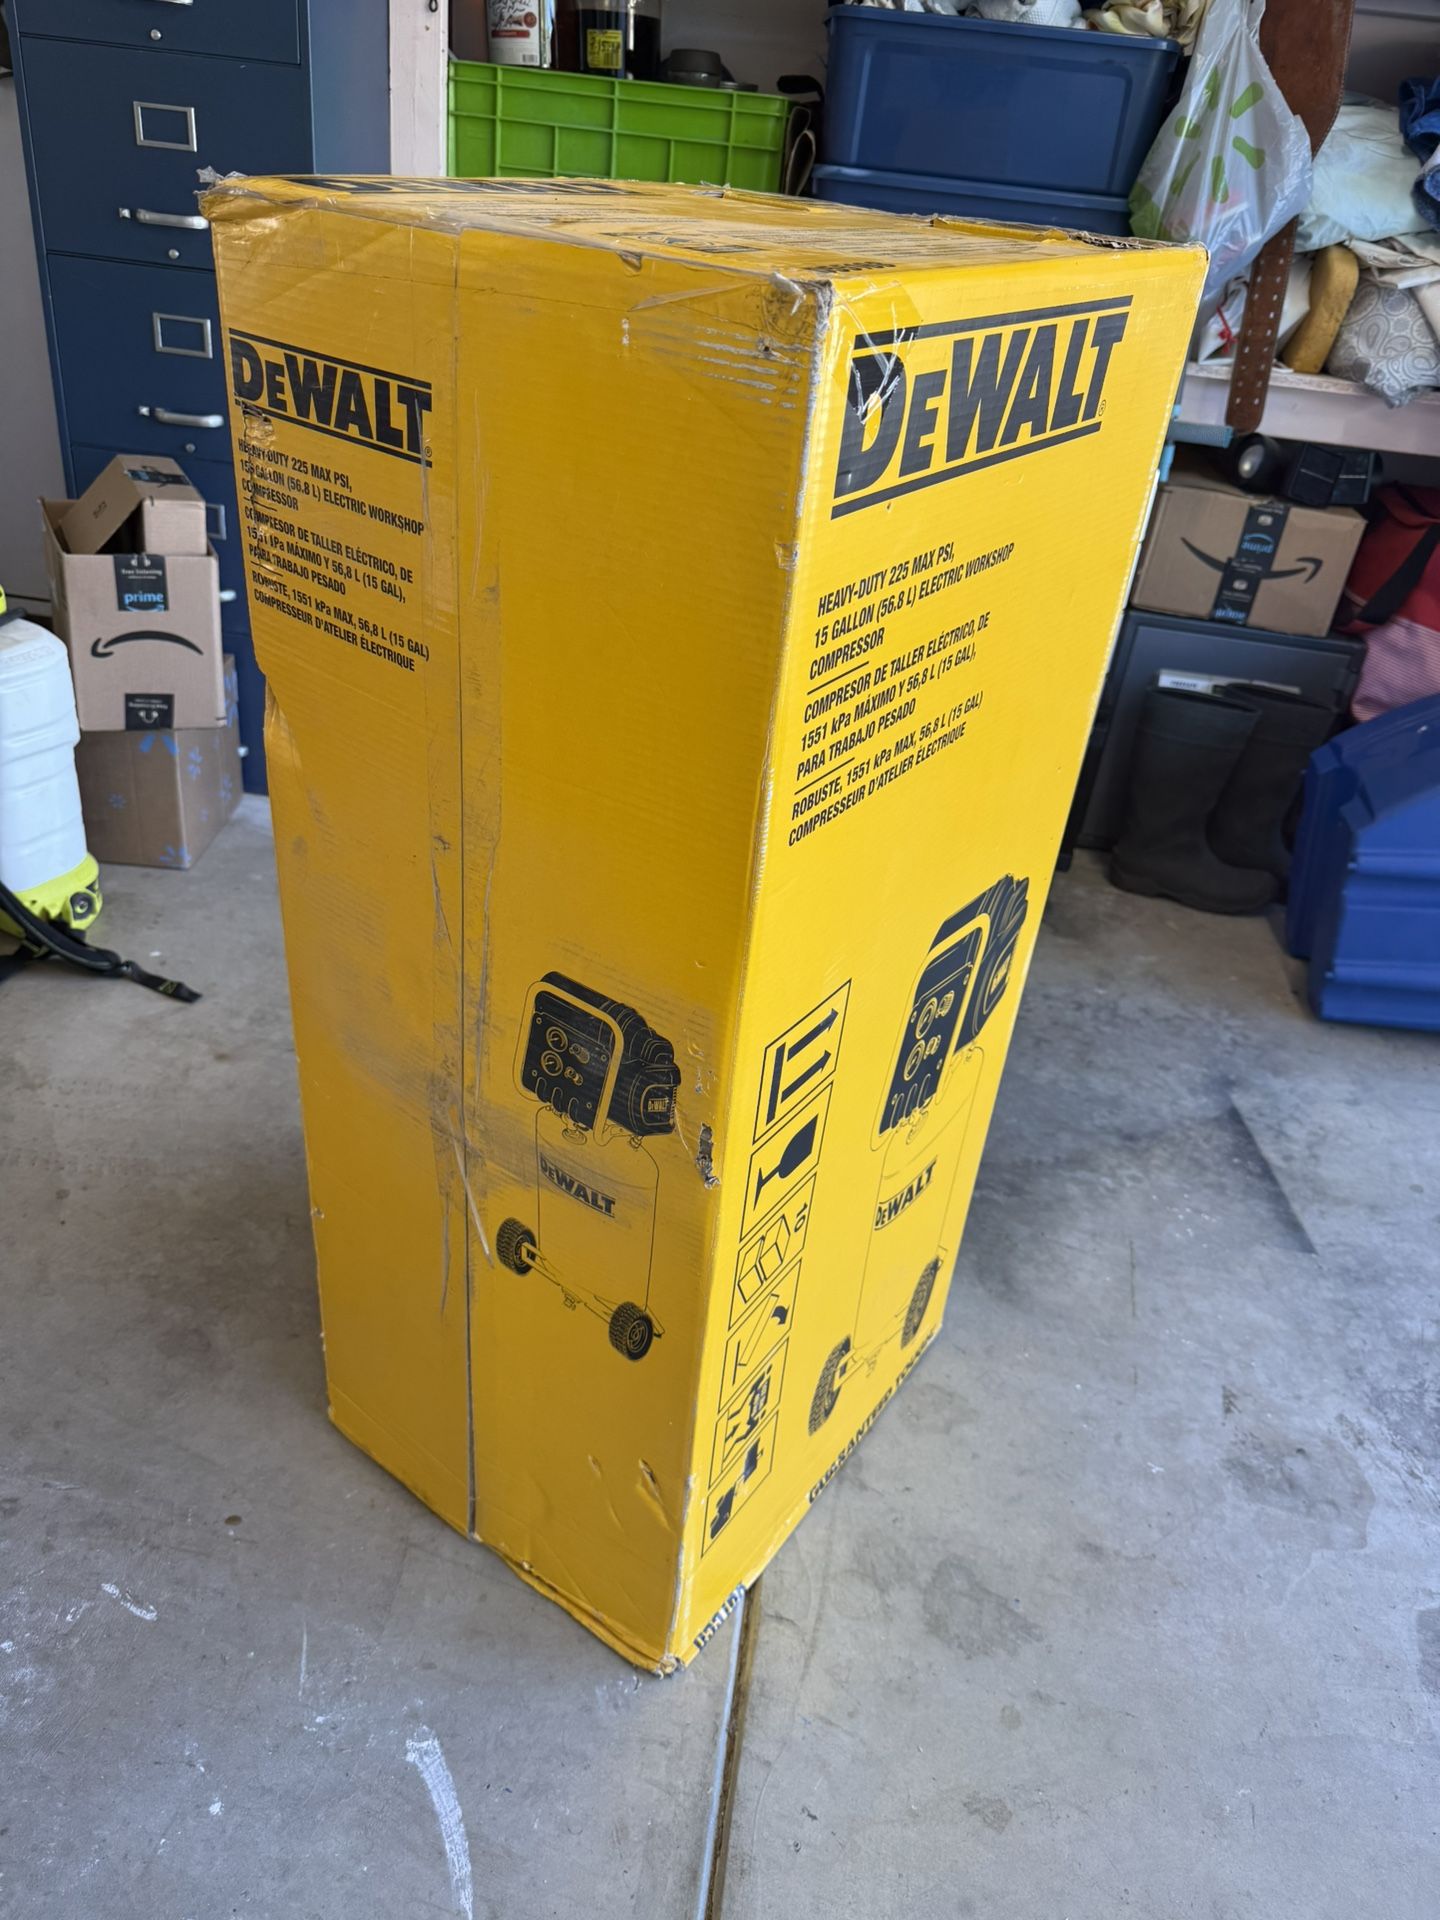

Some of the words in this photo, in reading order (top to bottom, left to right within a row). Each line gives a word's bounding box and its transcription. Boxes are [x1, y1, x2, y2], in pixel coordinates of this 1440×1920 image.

[230, 338, 432, 454] DEWALT
[833, 311, 1130, 499] DEWALT
[242, 478, 299, 511] COMPRESSOR
[287, 476, 311, 496] (56.8
[312, 484, 321, 502] L)
[323, 488, 367, 516] ELECTRIC
[368, 503, 425, 536] WORKSHOP
[291, 457, 309, 475] 225
[310, 463, 332, 483] MAX
[334, 471, 353, 493] PSI,
[272, 553, 310, 580] TRABAJO
[311, 570, 346, 596] PESADO
[286, 541, 322, 567] MÁXIMO
[323, 555, 330, 570] Y
[332, 560, 353, 580] 56,8
[354, 569, 361, 582] L
[363, 572, 378, 590] (15
[380, 579, 406, 604] GAL),
[297, 527, 310, 543] DE
[310, 532, 343, 556] TALLER
[345, 546, 398, 580] ELÉCTRICO,
[400, 567, 414, 584] DE
[817, 568, 888, 618] HEAVY-DUTY
[888, 560, 911, 586] 225
[911, 548, 937, 577] MAX
[936, 541, 955, 565] PSI,
[124, 591, 164, 605] prime
[252, 570, 291, 601] ROBUSTE,
[292, 588, 312, 608] 1551
[315, 598, 331, 616] kPa
[333, 606, 357, 630] MAX,
[358, 617, 379, 637] 56,8
[381, 626, 387, 641] L
[389, 630, 405, 649] (15
[407, 638, 430, 662] GAL)
[254, 588, 313, 627] COMPRESSEUR
[315, 616, 358, 647] D'ATELIER
[360, 633, 416, 672] ÉLECTRIQUE
[815, 624, 829, 649] 15
[831, 603, 875, 641] GALLON
[876, 590, 905, 624] (56.8
[905, 584, 917, 608] L)
[918, 563, 964, 600] ELECTRIC
[965, 542, 1015, 580] WORKSHOP
[804, 672, 872, 724] COMPRESOR
[873, 663, 889, 687] DE
[890, 644, 925, 677] TALLER
[926, 619, 975, 659] ELÉCTRICO,
[977, 611, 991, 632] DE
[809, 627, 885, 680] COMPRESSOR
[801, 721, 828, 752] 1551
[830, 712, 852, 736] kPa
[853, 684, 897, 722] MÁXIMO
[898, 679, 906, 698] Y
[906, 667, 929, 693] 56,8
[929, 663, 935, 681] L
[937, 653, 954, 680] (15
[954, 642, 977, 667] GAL),
[791, 775, 843, 821] ROBUSTE,
[846, 758, 872, 786] 1551
[873, 748, 892, 770] kPa
[893, 730, 917, 757] MAX,
[918, 717, 940, 742] 56,8
[940, 713, 946, 729] L
[947, 703, 963, 727] (15
[963, 690, 984, 714] GAL)
[796, 749, 826, 781] PARA
[828, 720, 876, 762] TRABAJO
[877, 697, 917, 734] PESADO
[789, 784, 866, 847] COMPRESSEUR
[867, 754, 915, 796] D'ATELIER
[915, 721, 967, 766] ÉLECTRIQUE
[540, 1152, 616, 1214] DEWALT
[794, 1202, 808, 1233] 10
[875, 1159, 937, 1227] DEWALT
